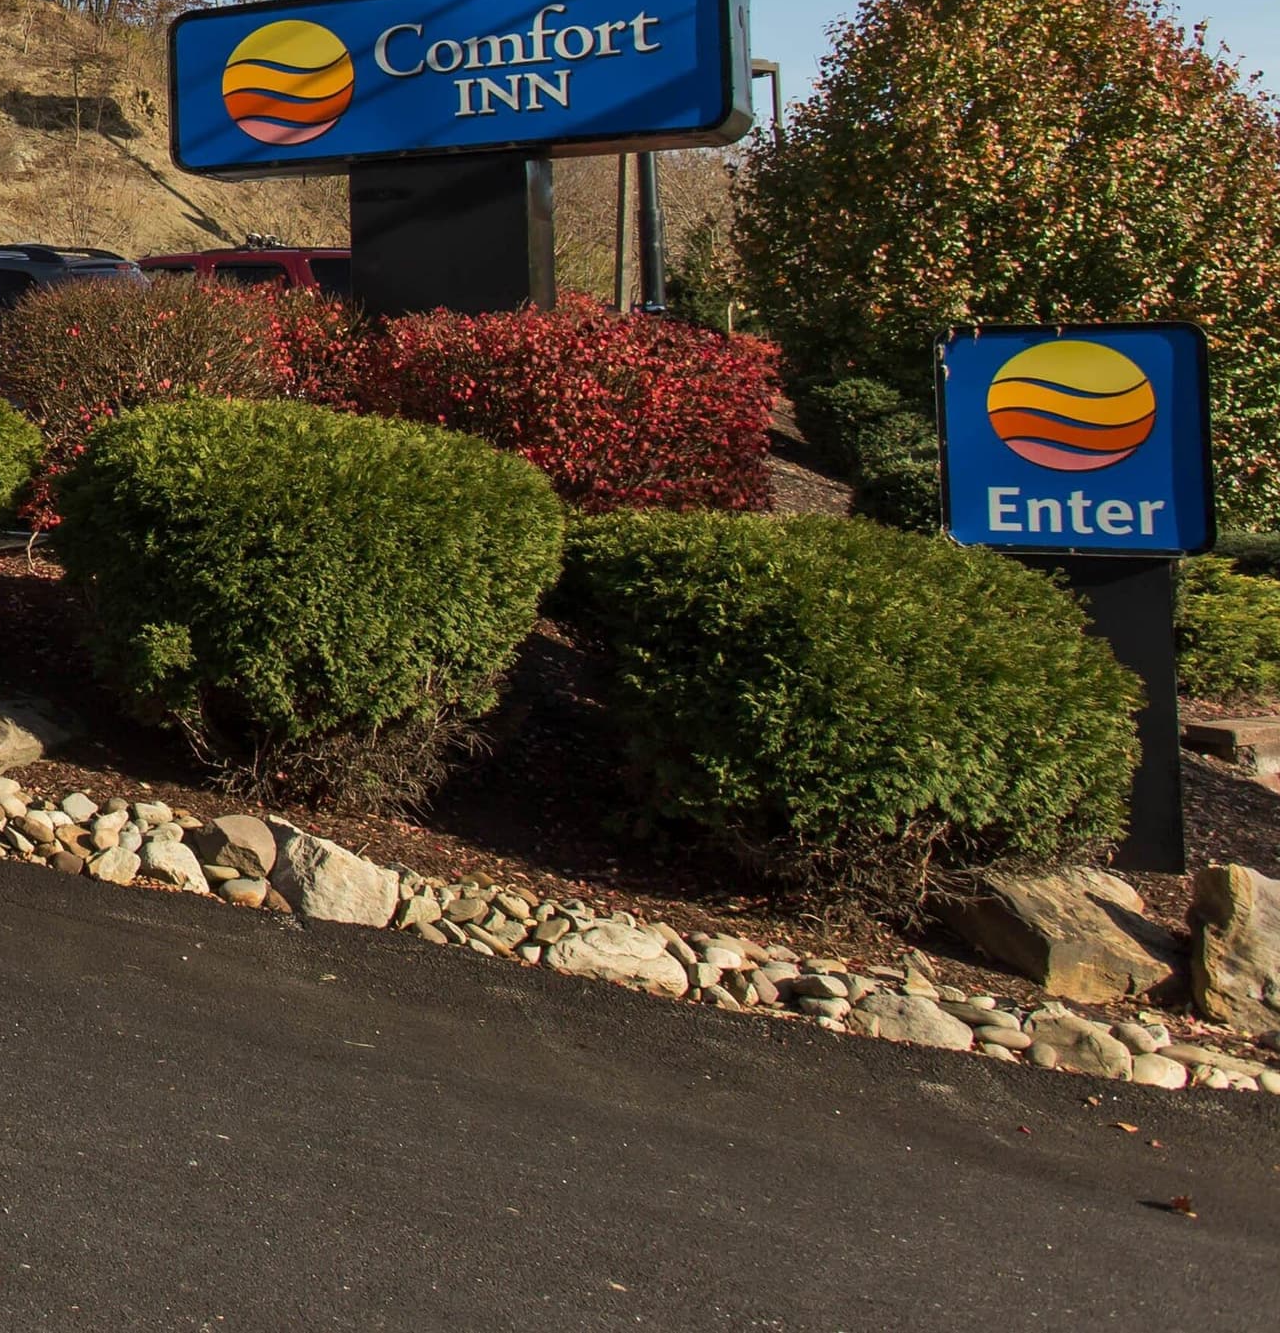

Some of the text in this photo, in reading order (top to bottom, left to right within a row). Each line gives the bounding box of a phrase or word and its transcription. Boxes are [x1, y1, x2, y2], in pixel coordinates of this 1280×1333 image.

[374, 3, 661, 77] Comfort
[454, 69, 571, 117] INN
[987, 486, 1166, 536] Enter
